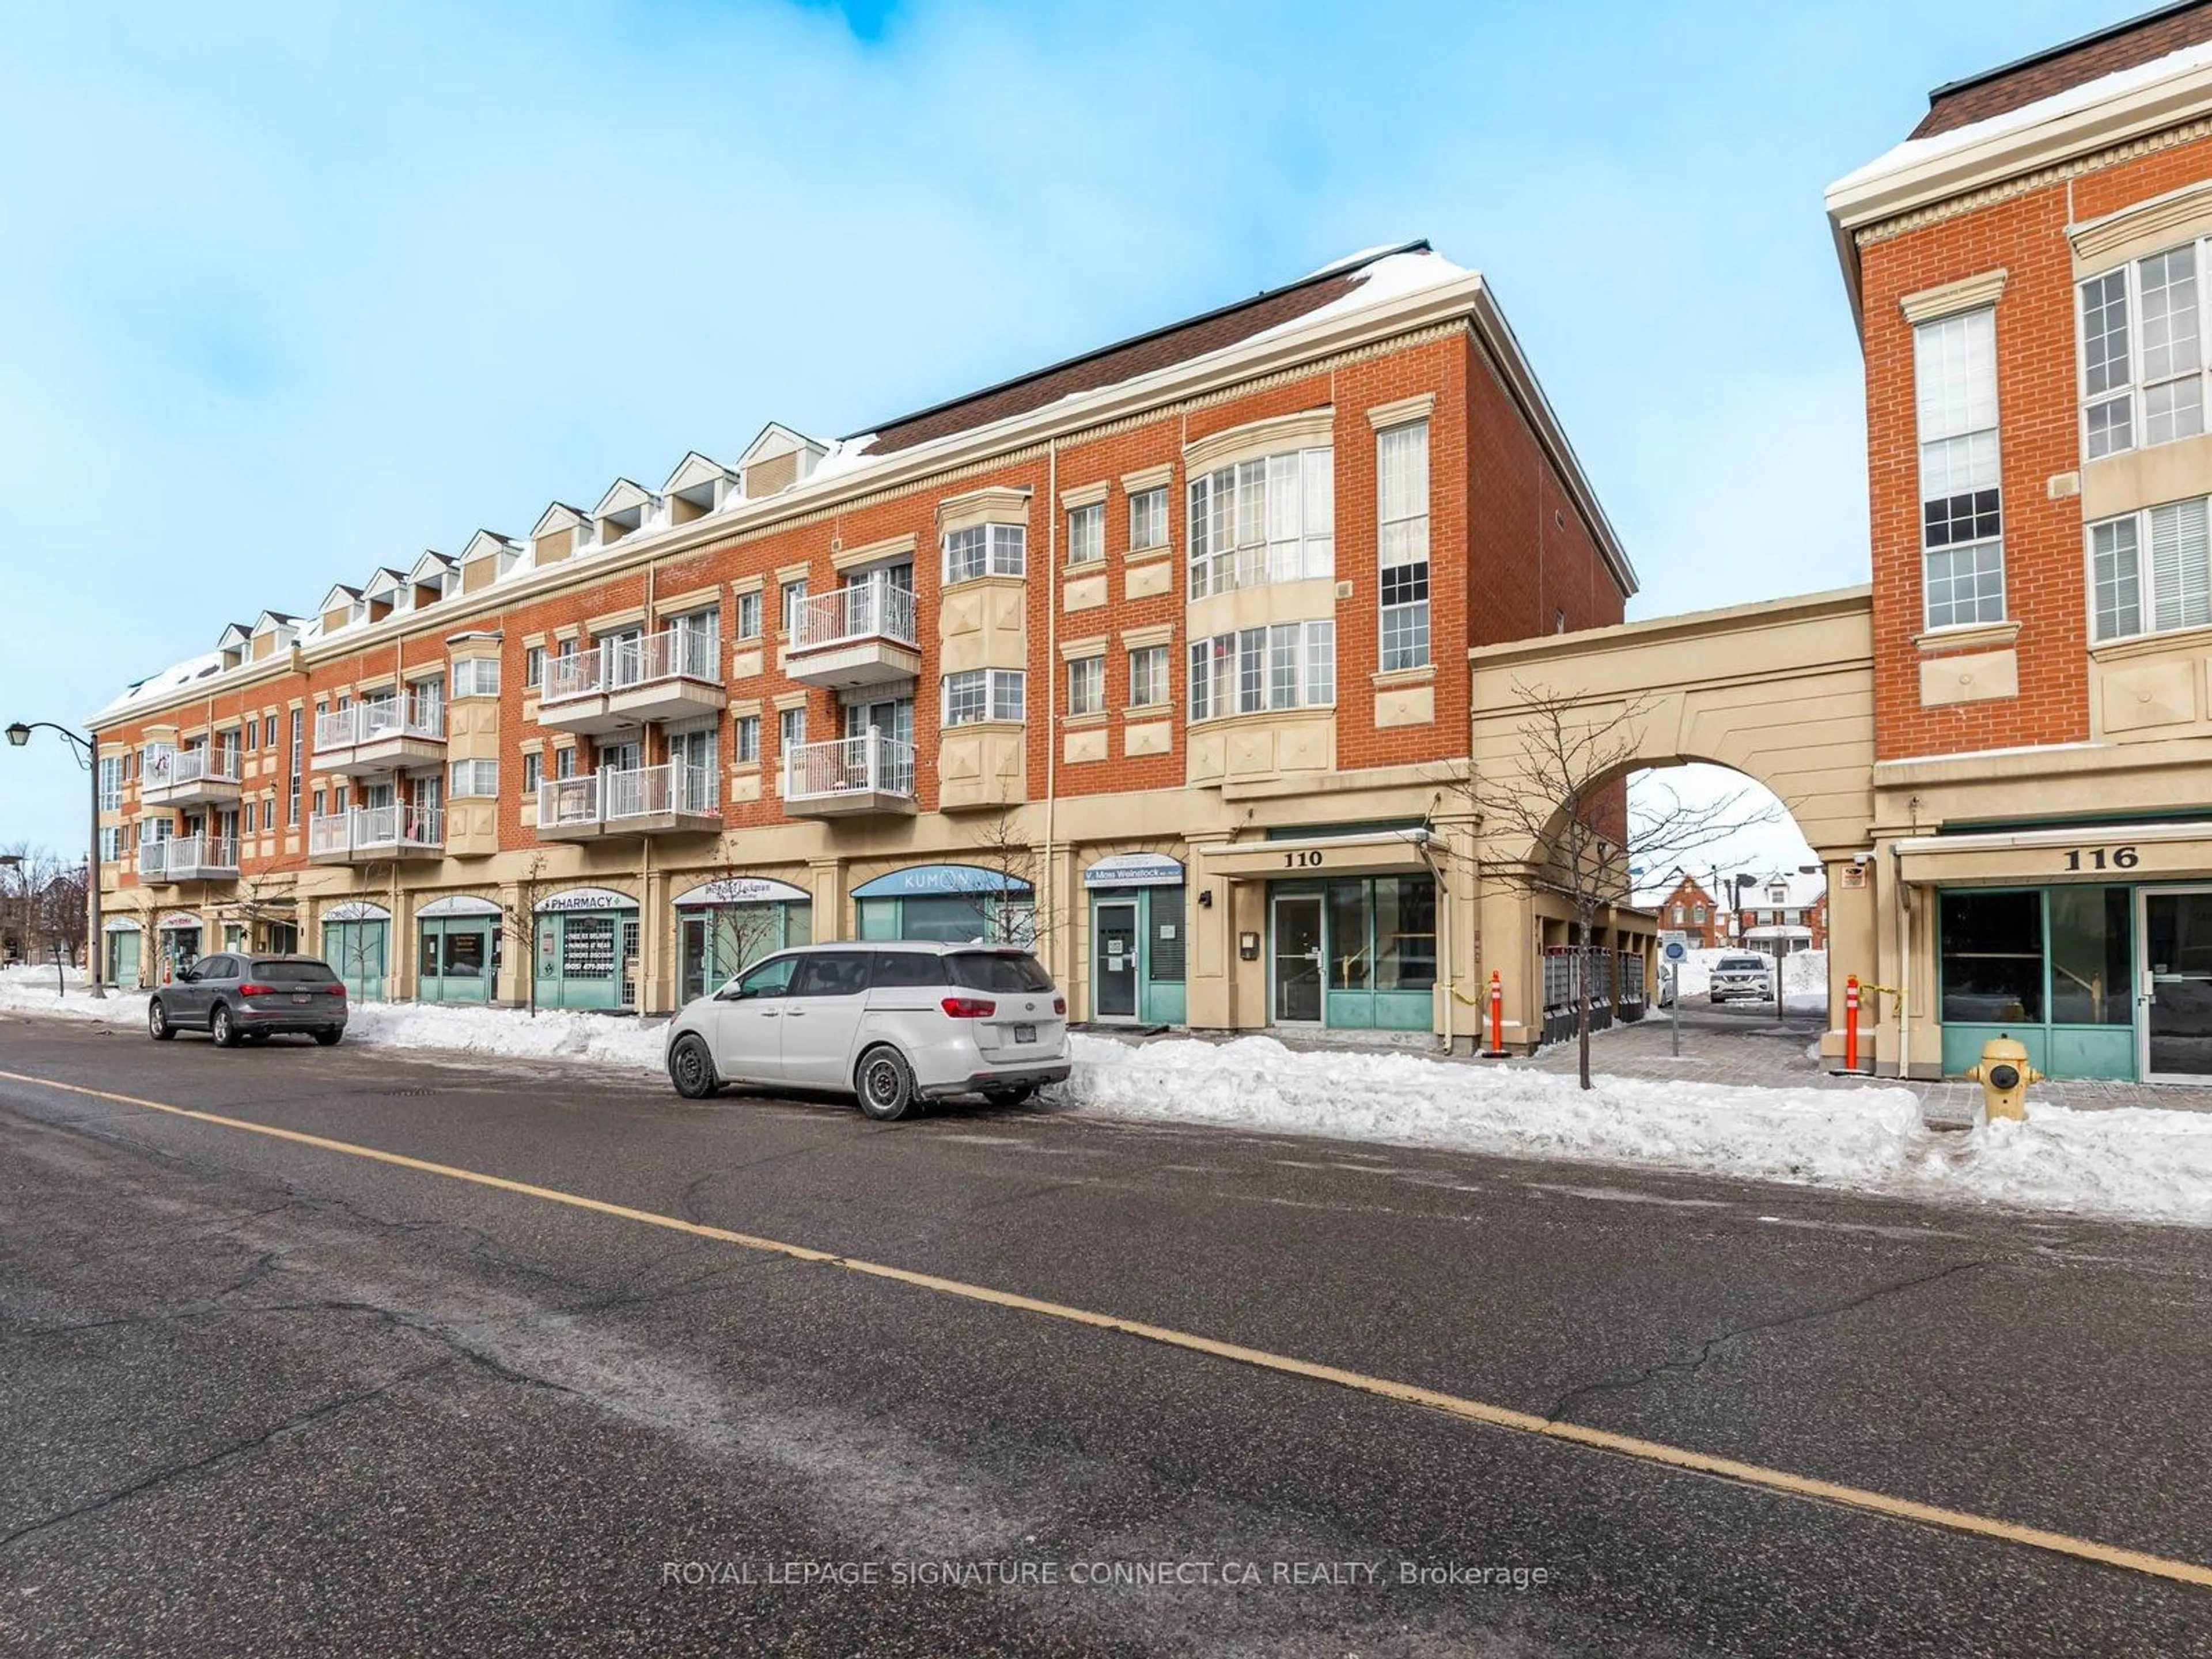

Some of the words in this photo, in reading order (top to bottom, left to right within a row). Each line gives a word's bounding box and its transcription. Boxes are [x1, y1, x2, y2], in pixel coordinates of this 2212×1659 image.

[1284, 850, 1322, 868] 110
[2064, 847, 2139, 871] 116
[905, 870, 969, 889] KUMON
[1086, 872, 1094, 880] V.
[1096, 870, 1115, 880] Moss
[1118, 869, 1160, 878] Weinstock
[551, 896, 613, 908] PHARMACY
